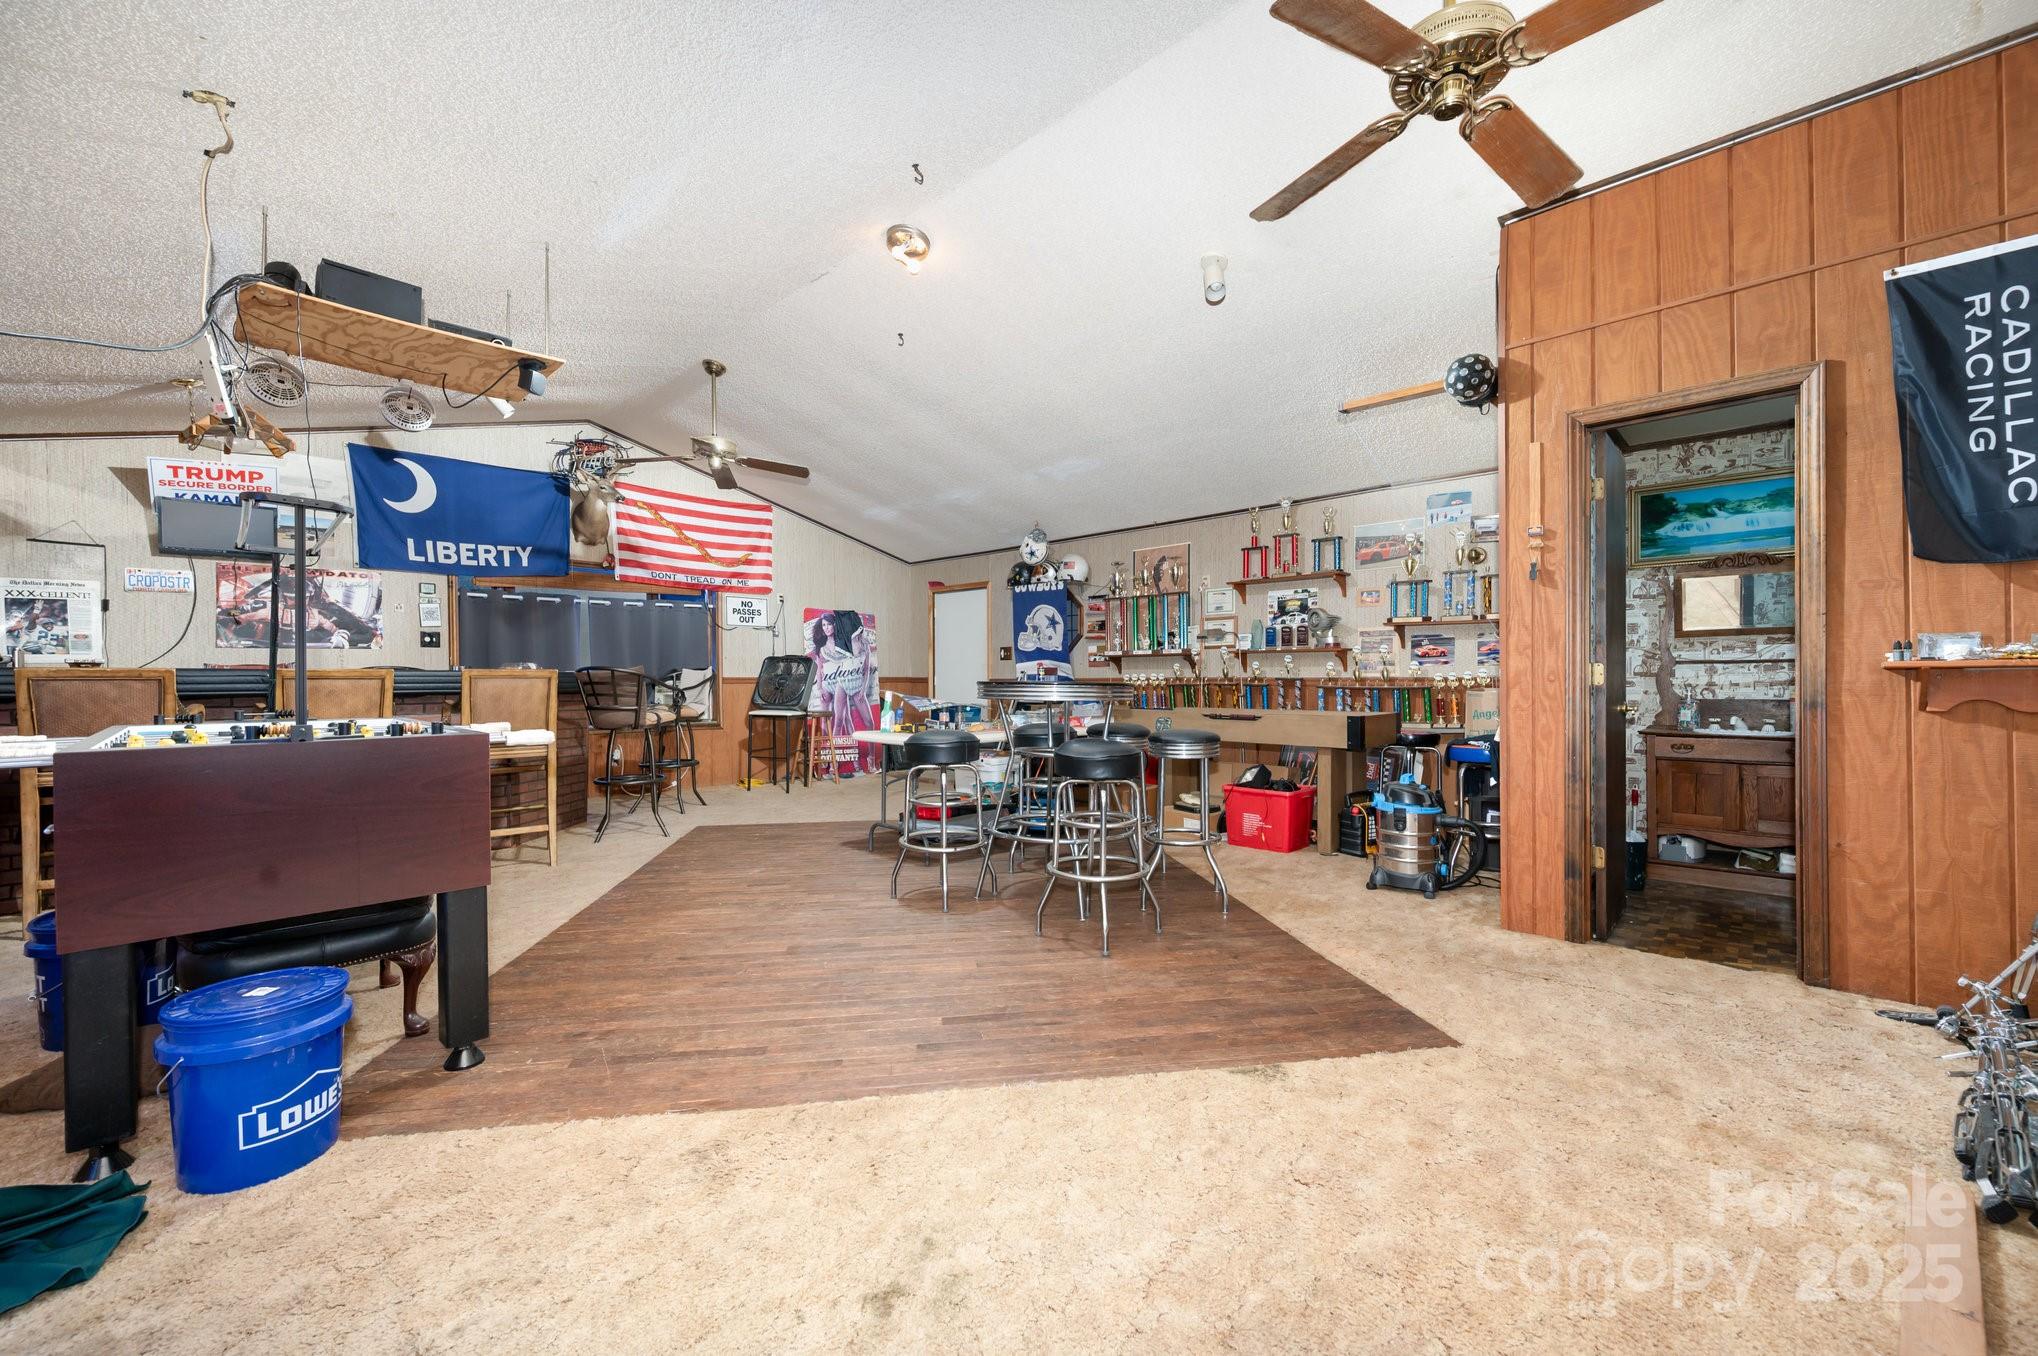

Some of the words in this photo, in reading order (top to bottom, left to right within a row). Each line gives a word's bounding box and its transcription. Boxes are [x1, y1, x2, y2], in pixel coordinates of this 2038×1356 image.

[1963, 291, 1997, 453] RACING
[2000, 284, 2038, 504] CADILLAC
[166, 464, 264, 483] TRUMP
[158, 479, 215, 490] SECURE
[218, 482, 273, 493] BORDER
[406, 537, 533, 568] LIBERTY
[651, 571, 677, 581] DONT
[685, 575, 716, 584] TREAD
[722, 578, 732, 586] ON
[737, 579, 750, 587] ME
[732, 607, 762, 616] PASSES
[740, 600, 753, 609] NO
[738, 615, 755, 624] OUT
